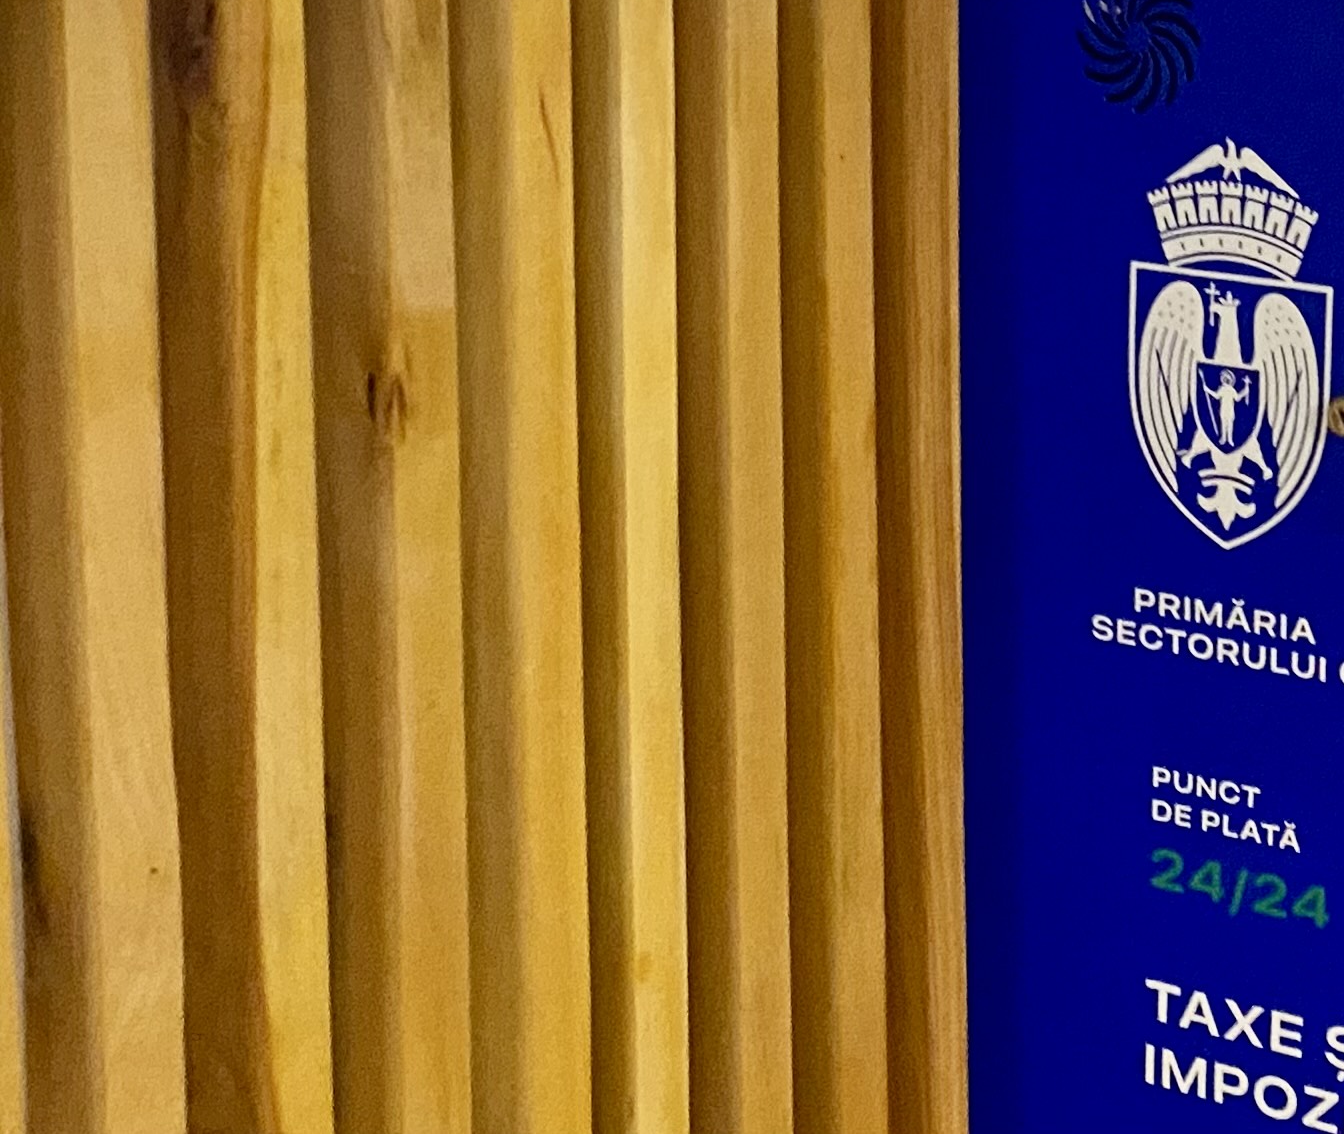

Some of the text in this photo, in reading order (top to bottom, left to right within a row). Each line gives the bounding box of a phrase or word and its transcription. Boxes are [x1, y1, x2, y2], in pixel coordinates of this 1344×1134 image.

[1133, 586, 1317, 645] PRIMĂRIA
[1091, 615, 1327, 684] SECTORULUI
[1151, 765, 1262, 809] PUNCT
[1151, 798, 1301, 854] DE PLATĂ
[1150, 847, 1331, 929] 24/24
[1144, 978, 1305, 1059] TAXE
